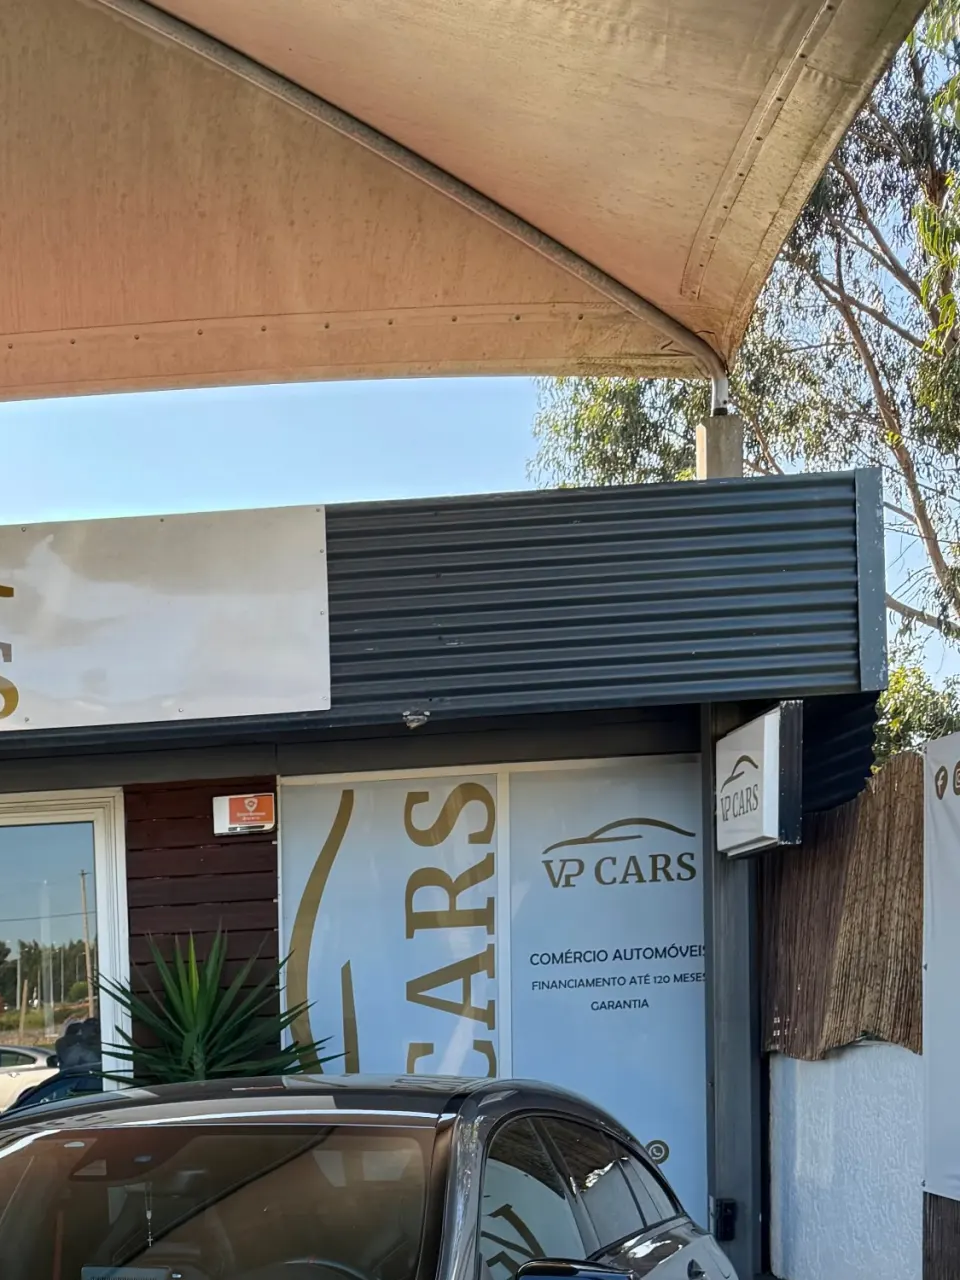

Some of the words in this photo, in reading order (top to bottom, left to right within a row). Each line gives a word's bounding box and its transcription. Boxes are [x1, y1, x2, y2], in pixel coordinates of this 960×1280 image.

[720, 795, 731, 821] VP
[732, 784, 758, 818] CARS
[542, 858, 585, 888] VP
[595, 852, 697, 885] CARS
[530, 949, 608, 965] COMÉRCIO
[531, 976, 626, 991] FINANCIAMENTO
[629, 974, 650, 985] ATÉ
[653, 975, 670, 985] 120
[591, 999, 649, 1011] GARANTIA
